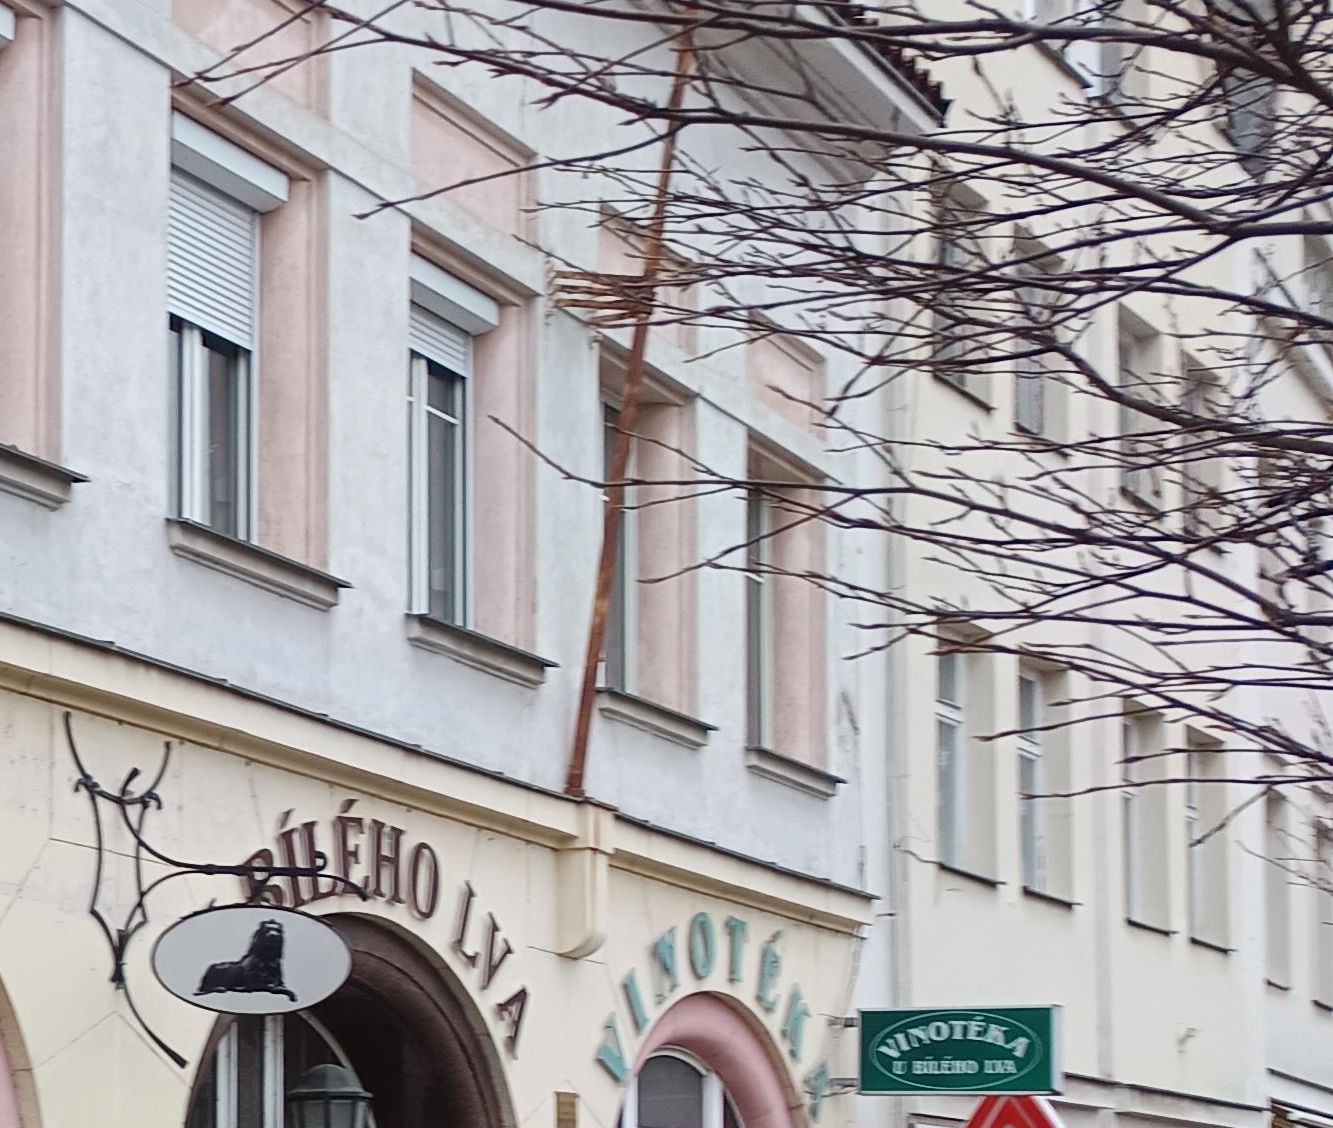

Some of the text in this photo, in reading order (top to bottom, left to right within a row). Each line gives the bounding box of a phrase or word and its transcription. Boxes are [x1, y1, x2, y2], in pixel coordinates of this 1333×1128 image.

[241, 799, 529, 1061] BÍLÉHO LVA
[595, 911, 830, 1123] VINOTÉKA
[877, 1016, 1031, 1058] VINOTÉKA
[892, 1060, 908, 1075] U
[984, 1060, 1018, 1075] LVA
